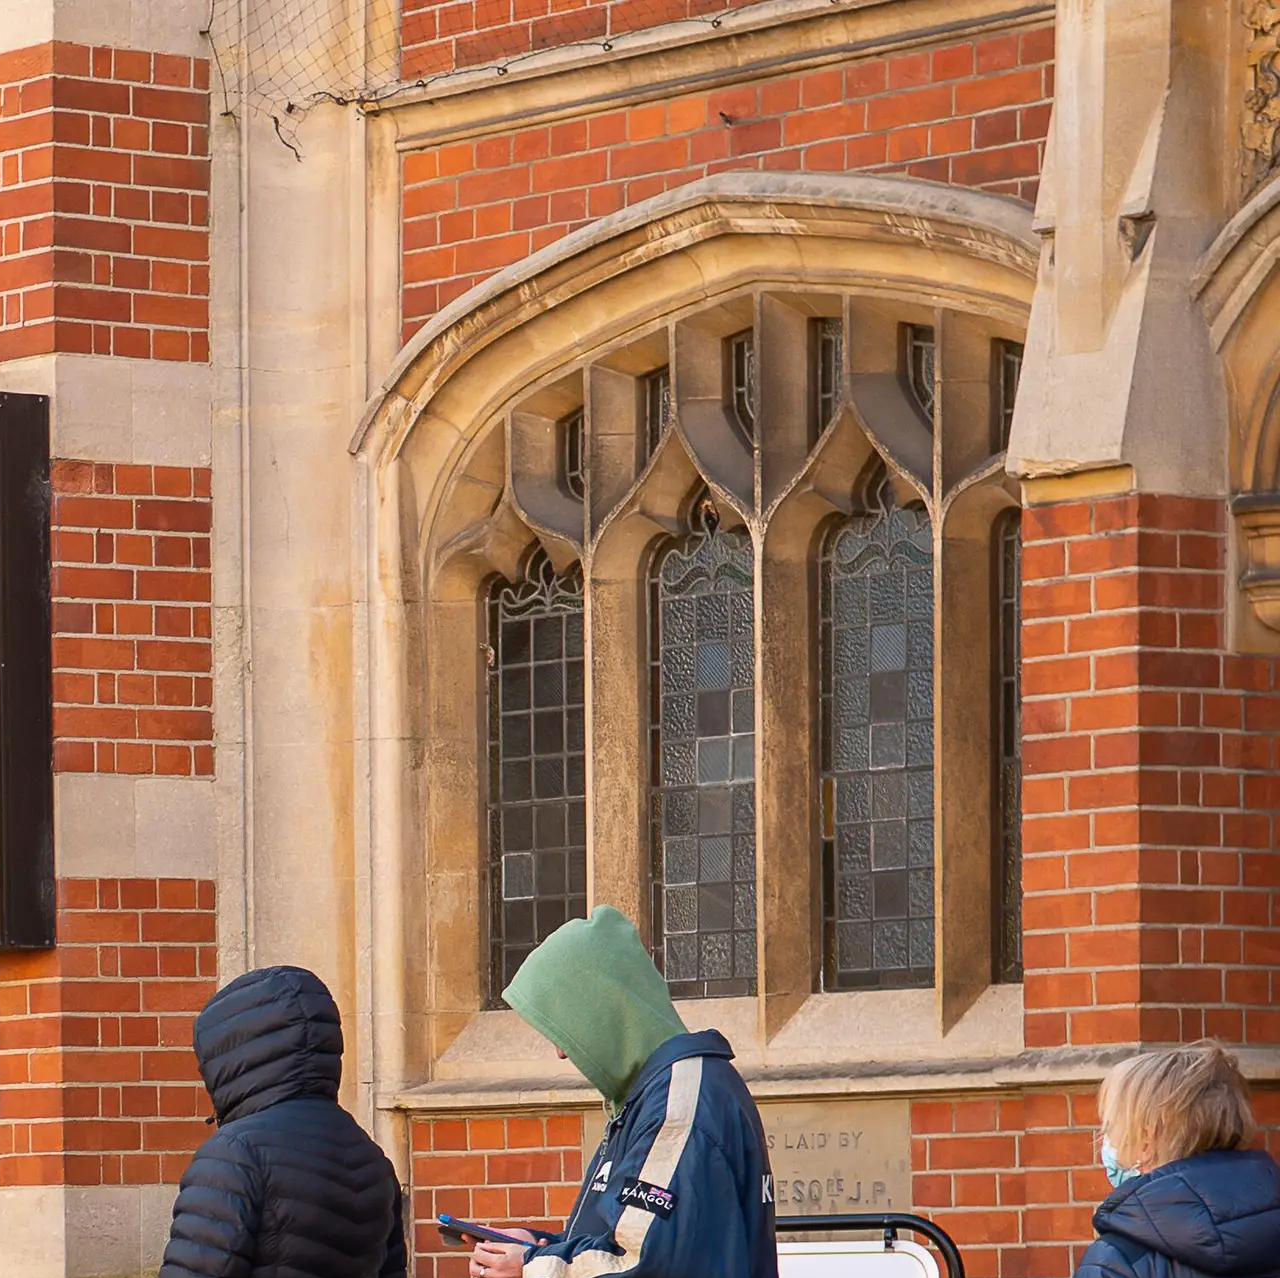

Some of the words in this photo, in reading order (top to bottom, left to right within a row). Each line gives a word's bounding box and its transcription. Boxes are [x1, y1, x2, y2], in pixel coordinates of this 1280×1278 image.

[784, 1132, 828, 1150] LAID
[839, 1131, 865, 1149] BY
[621, 1187, 673, 1211] KANGOL
